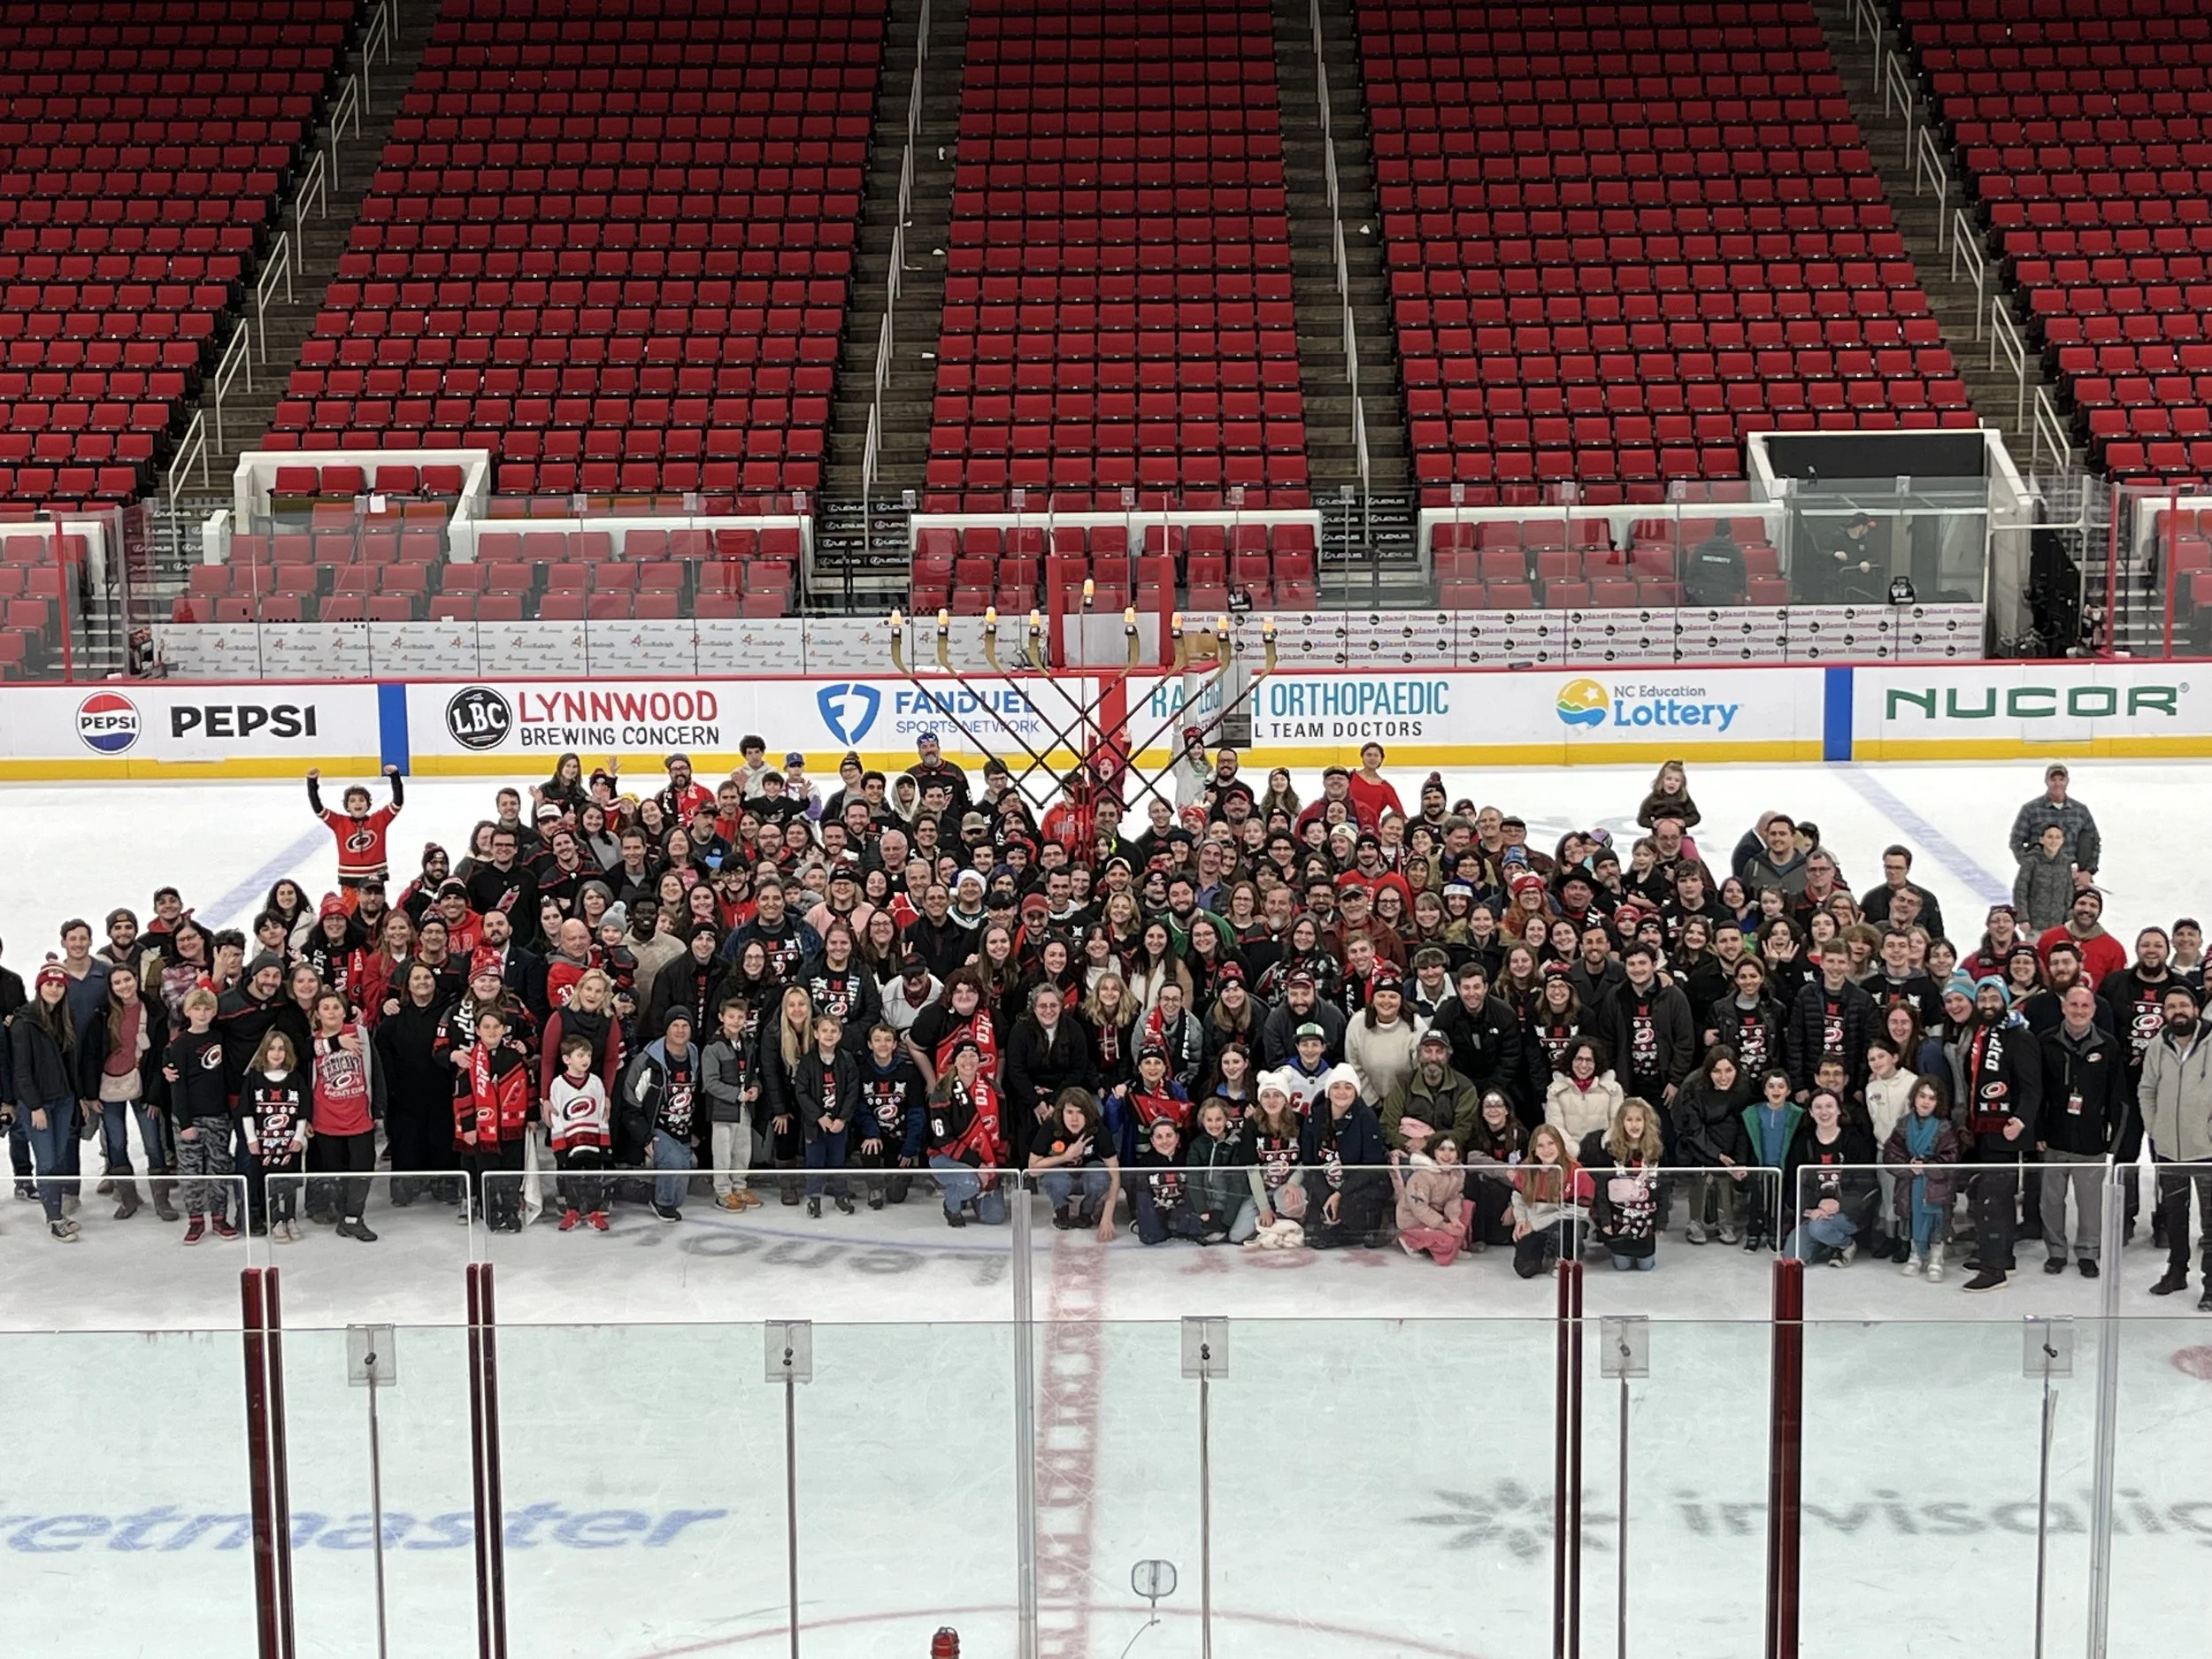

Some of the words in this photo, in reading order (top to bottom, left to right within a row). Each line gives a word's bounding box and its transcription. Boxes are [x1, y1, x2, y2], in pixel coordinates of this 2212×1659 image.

[895, 690, 1038, 715] FANDUEL
[1271, 680, 1449, 717] ORTHOPAEDIC
[1614, 686, 1635, 697] NC
[1639, 685, 1706, 697] Education
[1886, 686, 2177, 720] NUCOR
[452, 702, 506, 734] LBC
[518, 689, 718, 723] LYNNWOOD
[1613, 699, 1740, 733] Lottery
[81, 716, 136, 729] PEPSI
[170, 704, 317, 738] PEPSI
[896, 720, 958, 733] SPORTS
[960, 718, 1040, 733] NETWORK
[1271, 722, 1325, 738] TEAM
[1333, 721, 1423, 737] DOCTORS
[520, 726, 616, 746] BREWING
[623, 726, 719, 746] CONCERN
